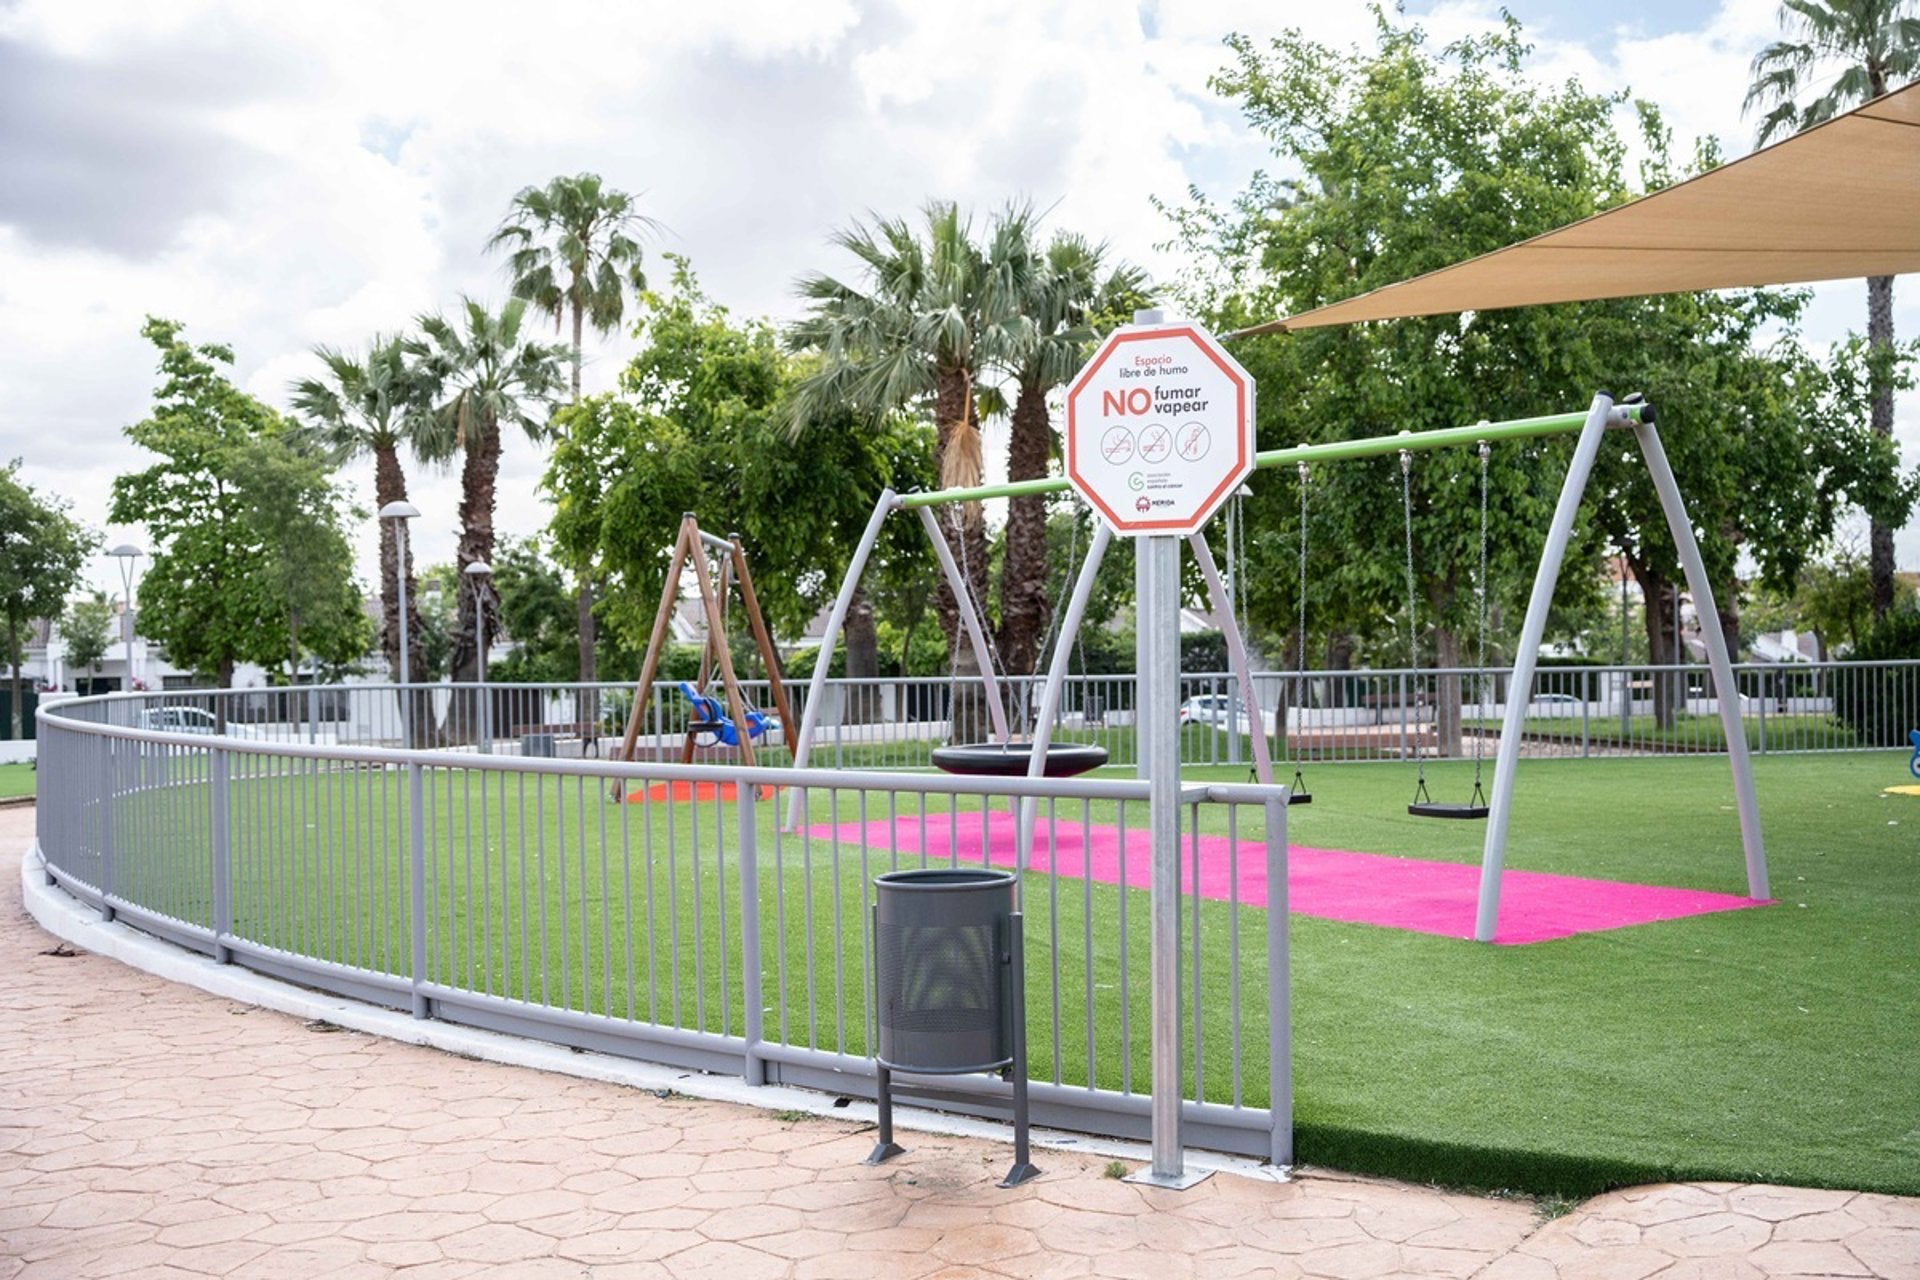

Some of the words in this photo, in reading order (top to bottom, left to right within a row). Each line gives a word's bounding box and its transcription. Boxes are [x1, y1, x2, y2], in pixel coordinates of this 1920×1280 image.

[1135, 353, 1172, 368] Espacio
[1119, 367, 1141, 378] libre
[1143, 366, 1156, 377] de
[1159, 365, 1189, 375] humo
[1103, 387, 1152, 417] NO
[1154, 385, 1201, 400] fumar
[1154, 401, 1208, 416] vapear
